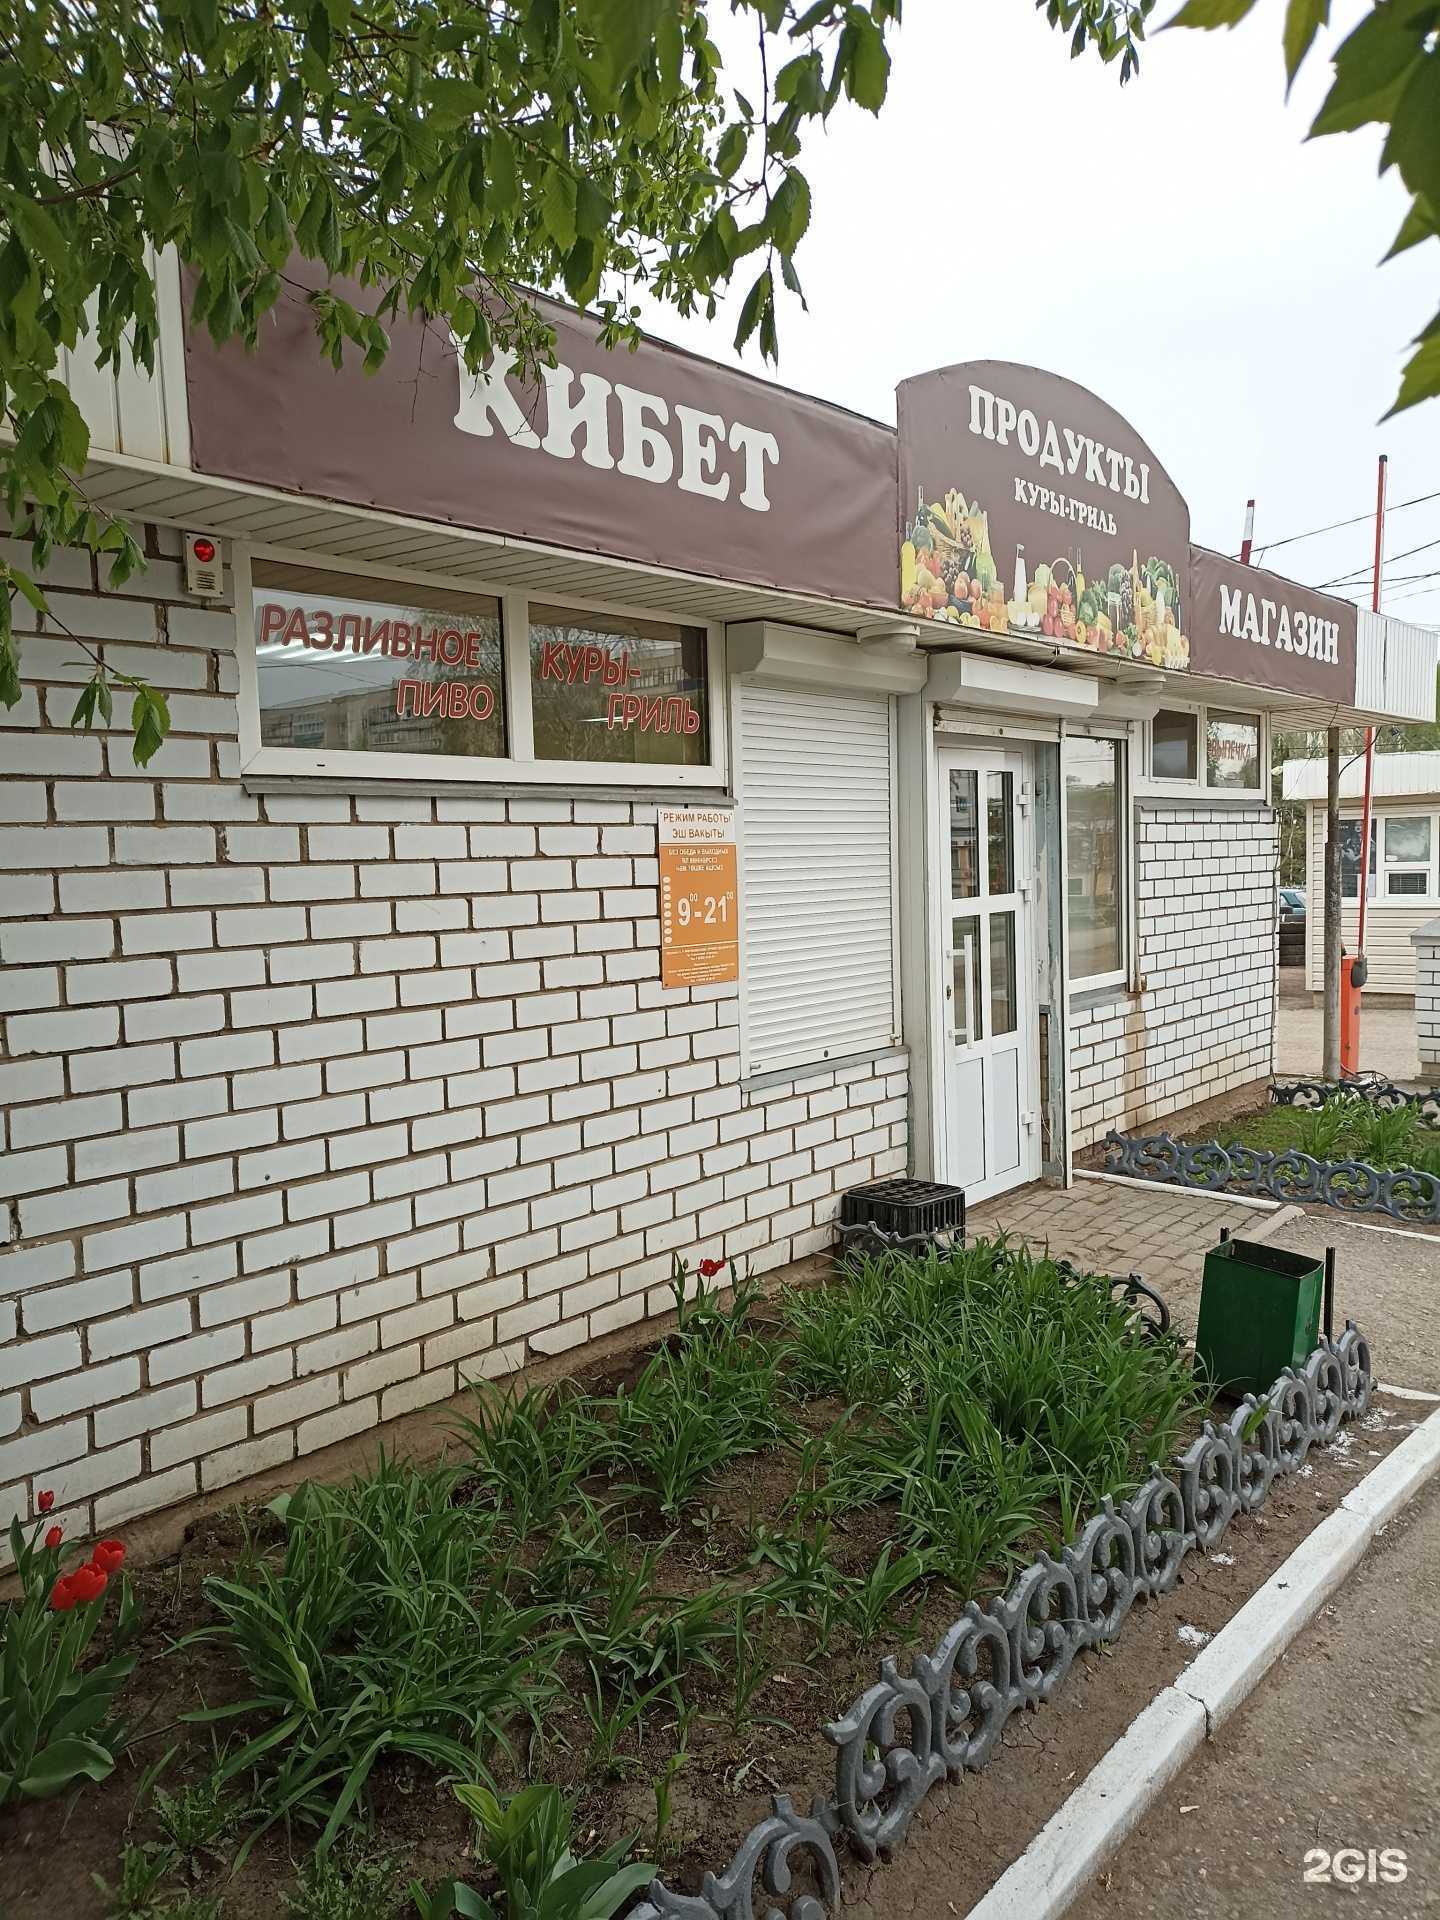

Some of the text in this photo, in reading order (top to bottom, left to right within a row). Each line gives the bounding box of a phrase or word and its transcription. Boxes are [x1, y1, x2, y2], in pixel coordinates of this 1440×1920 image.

[449, 327, 780, 512] КИБЕТ
[968, 385, 1150, 504] ПРОДУКТЫ
[1014, 478, 1117, 536] КУРЫ-ГРИЛЬ
[260, 603, 482, 668] РАЗЛИВНОЕ
[1219, 584, 1340, 665] МАГАЗИН
[540, 640, 642, 686] КУРЫ-
[395, 678, 495, 721] ПИВО
[606, 691, 701, 734] ГРИЛЬ
[663, 812, 731, 823] РЕЖИМ РАБОТЫ
[672, 828, 725, 839] ЭШ ВАКЫТЫ
